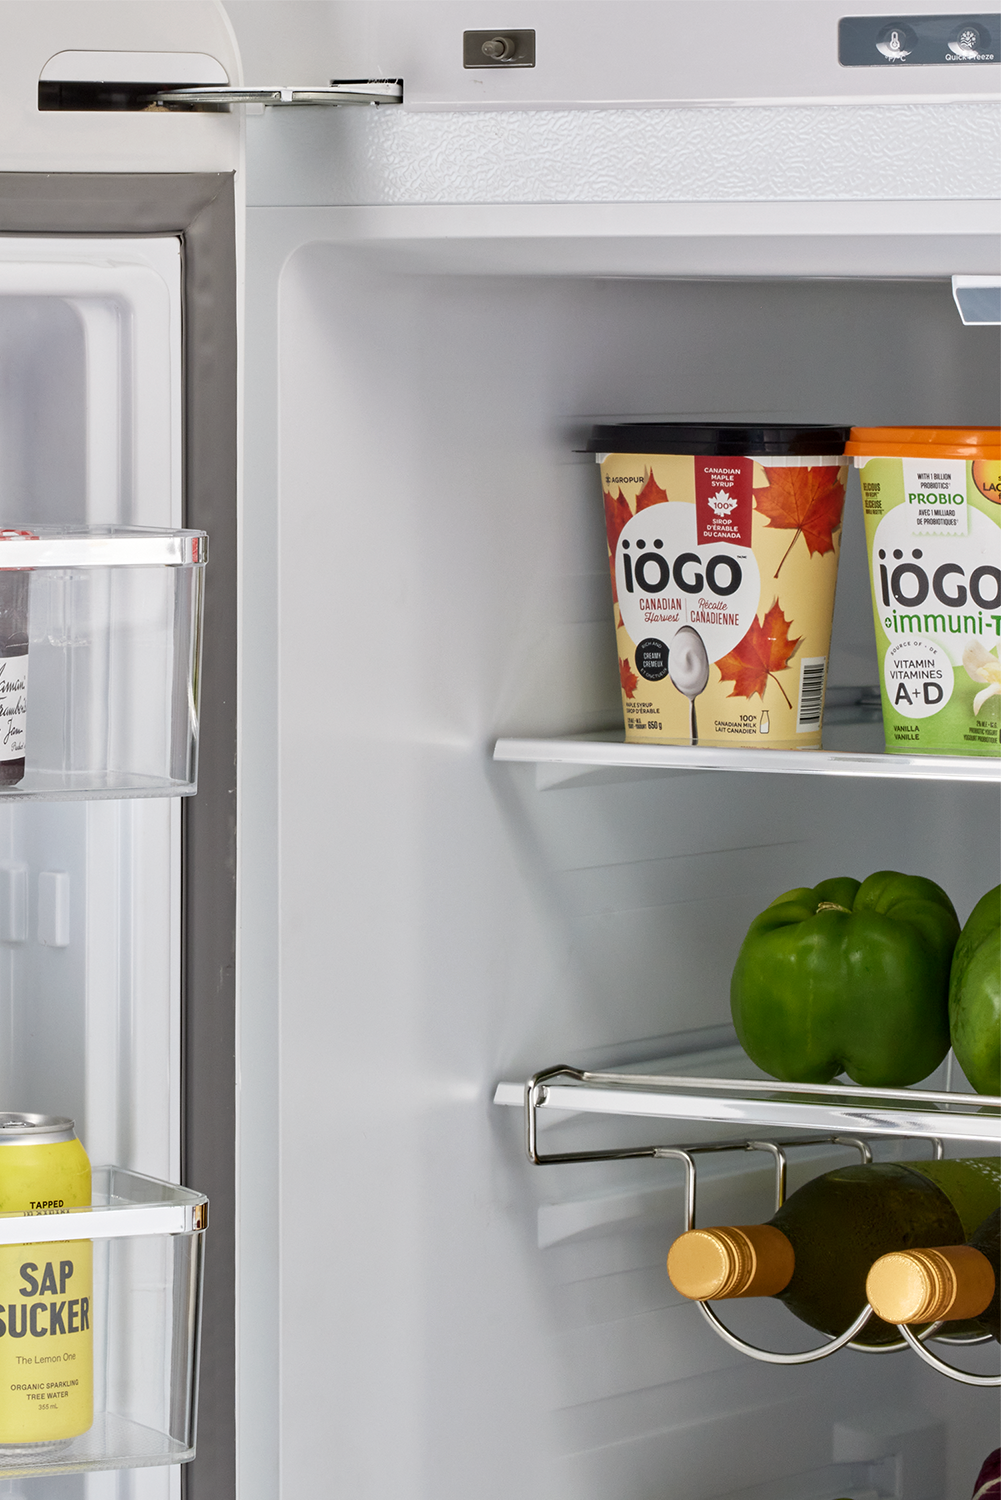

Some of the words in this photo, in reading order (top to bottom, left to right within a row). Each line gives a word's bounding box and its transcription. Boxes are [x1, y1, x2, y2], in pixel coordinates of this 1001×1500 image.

[704, 467, 741, 475] CANADIAN
[612, 476, 644, 484] AGROPUR
[711, 474, 734, 482] MAPLE
[908, 493, 964, 505] PROBIO
[714, 502, 734, 510] 100%
[706, 524, 738, 532] D'ÉRABLE
[639, 598, 682, 611] CANADIAN
[644, 612, 680, 623] Harvest
[690, 610, 740, 626] CANADIENNE
[890, 641, 911, 656] SOURCE
[894, 659, 935, 668] VITAMIN
[890, 670, 943, 679] VITAMINES
[714, 720, 742, 728] CANADIAN
[4, 718, 23, 745] Jam
[30, 1200, 64, 1210] TAPPED
[19, 1260, 74, 1297] SAP
[16, 1356, 32, 1365] The
[34, 1354, 61, 1364] Lemon
[63, 1353, 76, 1362] One
[10, 1383, 44, 1391] ORGANIC
[46, 1379, 79, 1390] SPARKLING
[26, 1393, 45, 1401] TREE
[47, 1391, 69, 1400] WATER
